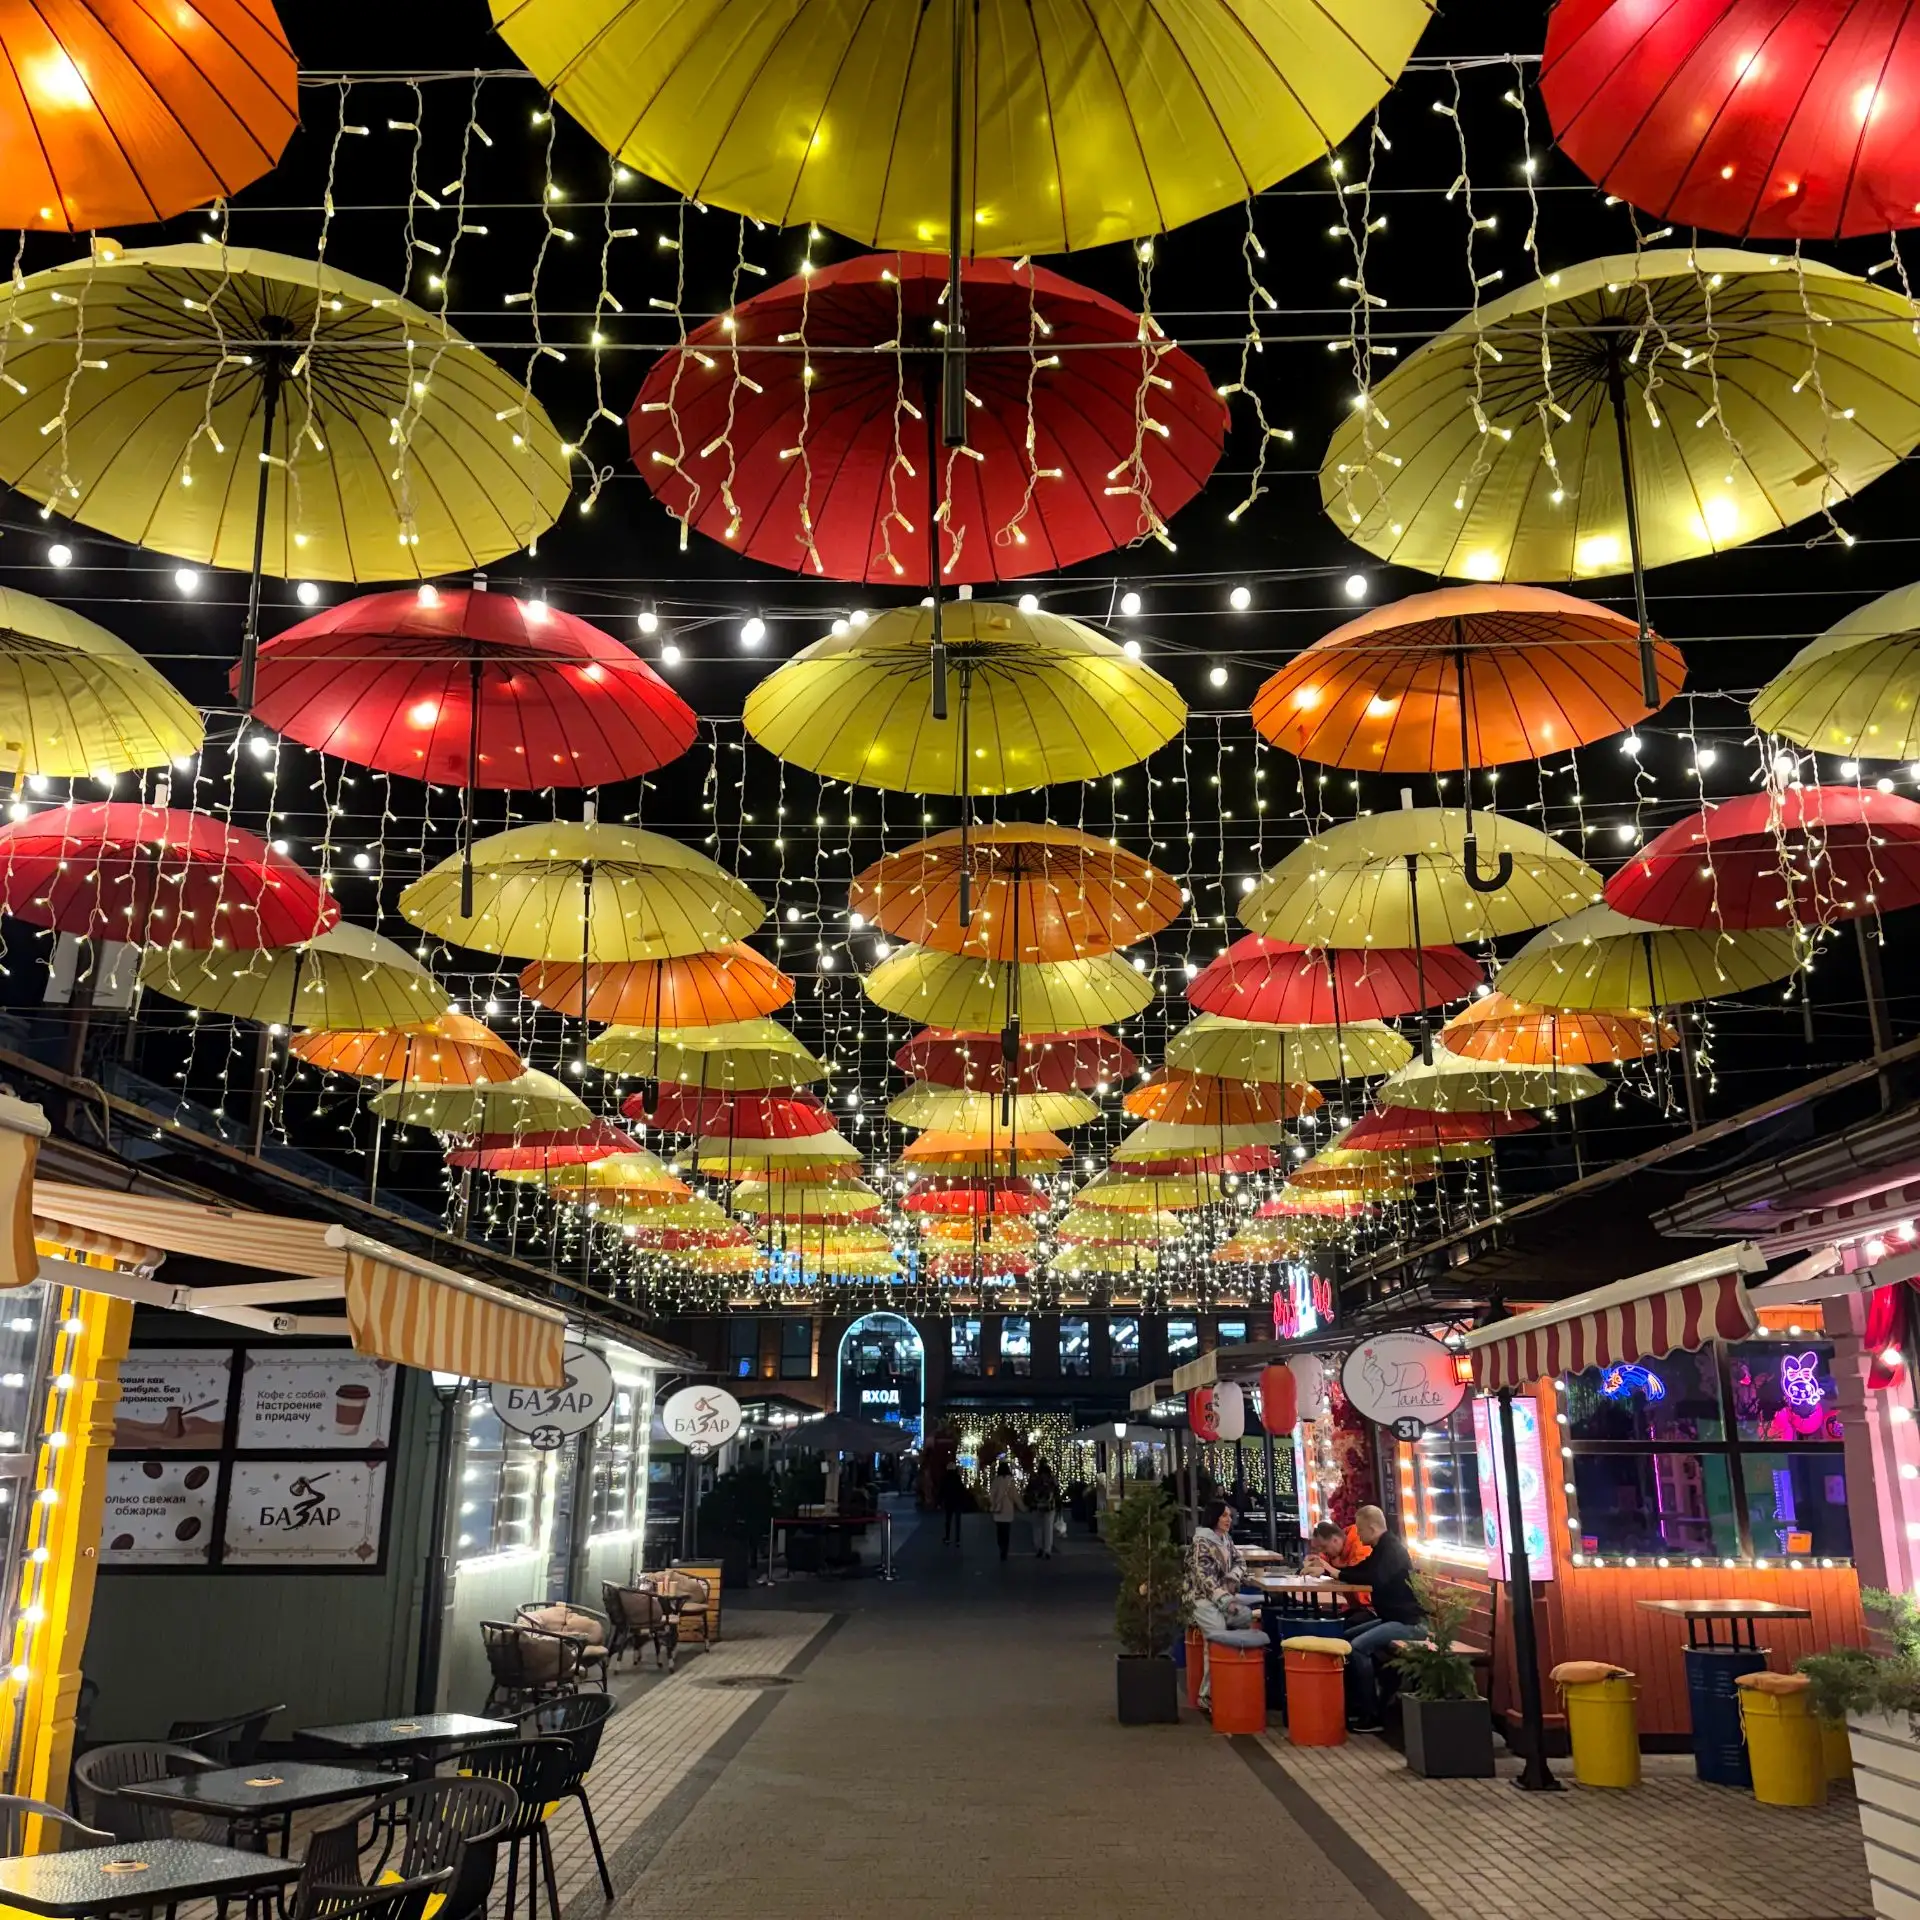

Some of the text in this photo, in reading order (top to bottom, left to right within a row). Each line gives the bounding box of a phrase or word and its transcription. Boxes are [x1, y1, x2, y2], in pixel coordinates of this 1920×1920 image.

[257, 1390, 285, 1400] Кофе
[507, 1381, 593, 1416] БАЗАР
[862, 1389, 899, 1404] ВХОД
[256, 1401, 322, 1412] Настроение
[255, 1412, 311, 1422] в придачу
[674, 1410, 730, 1436] БАЗАР
[1397, 1421, 1420, 1438] 31
[533, 1429, 561, 1447] 23
[690, 1442, 709, 1455] 25
[105, 1495, 186, 1504] олько свежая
[115, 1506, 166, 1517] обжарка
[259, 1498, 340, 1531] БАЗАР
